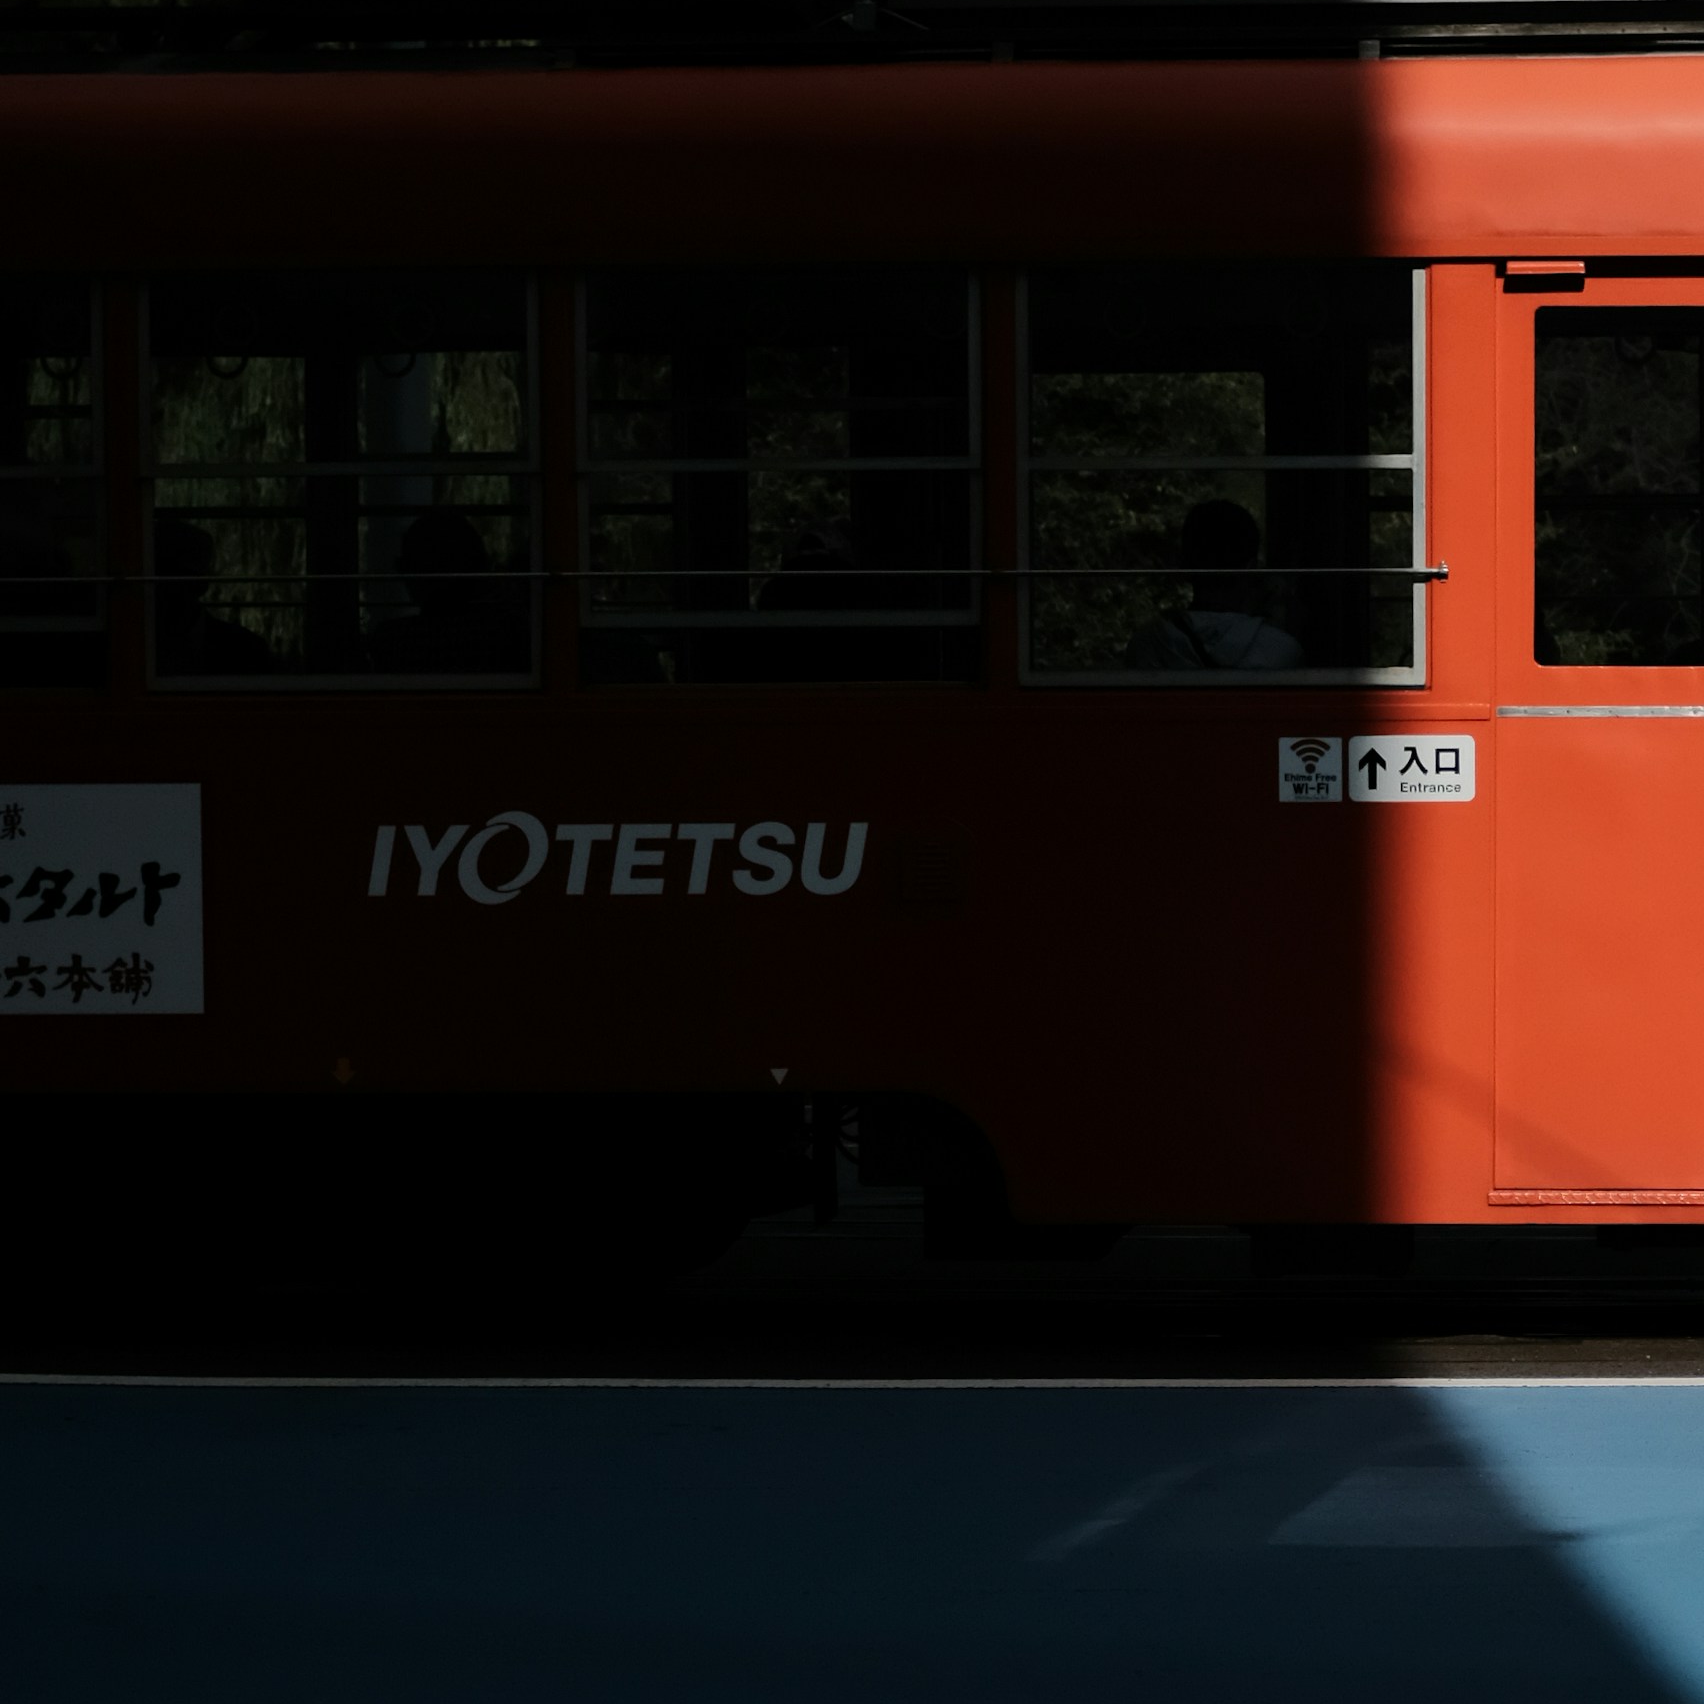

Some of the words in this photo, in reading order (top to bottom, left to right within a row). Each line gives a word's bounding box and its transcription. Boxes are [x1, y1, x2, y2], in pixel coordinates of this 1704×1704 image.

[1400, 746, 1460, 775] 入口
[1284, 773, 1312, 782] Ehime
[1315, 773, 1337, 782] Free
[1400, 782, 1462, 793] Entrance
[366, 809, 870, 906] IYOTETSU
[0, 952, 154, 1004] 六本舗
